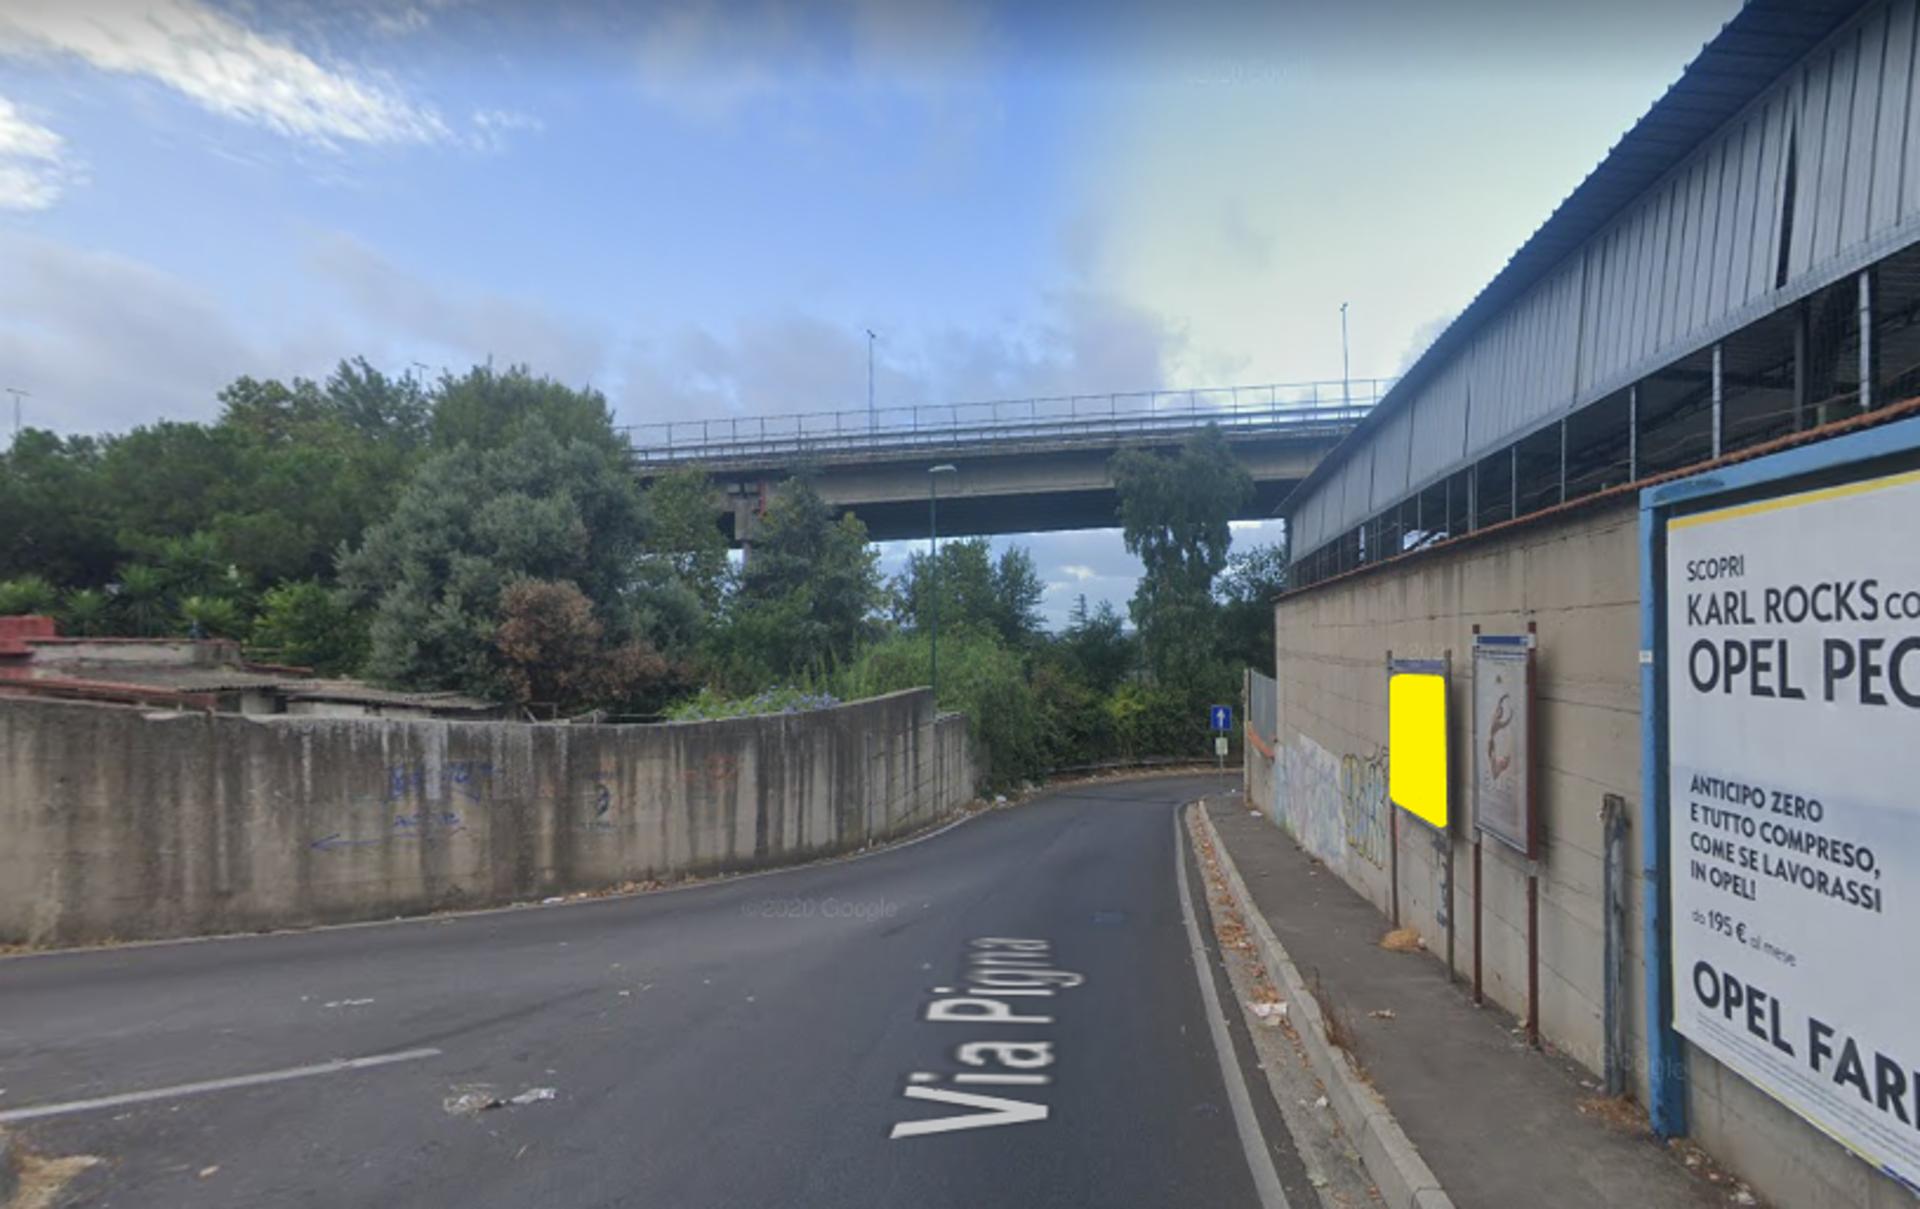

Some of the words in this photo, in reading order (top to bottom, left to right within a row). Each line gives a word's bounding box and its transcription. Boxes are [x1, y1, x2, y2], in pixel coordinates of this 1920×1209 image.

[1687, 554, 1745, 582] SCOPRI
[1687, 590, 1755, 626] KARL
[1764, 579, 1879, 624] ROCKS
[1688, 637, 1806, 701] OPEL
[1690, 774, 1766, 809] ANTICIPO
[1770, 790, 1824, 823] ZERO
[1690, 802, 1699, 822] E
[1702, 805, 1756, 838] TUTTO
[1759, 821, 1881, 880] COMPRESO,
[1690, 831, 1736, 864] COME
[1739, 845, 1759, 872] SE
[1763, 853, 1882, 913] LAVORASSI
[1690, 860, 1706, 883] IN
[1709, 866, 1757, 901] OPEL!
[1708, 909, 1733, 937] 195
[1736, 921, 1747, 944] €
[1693, 960, 1796, 1057] OPEL
